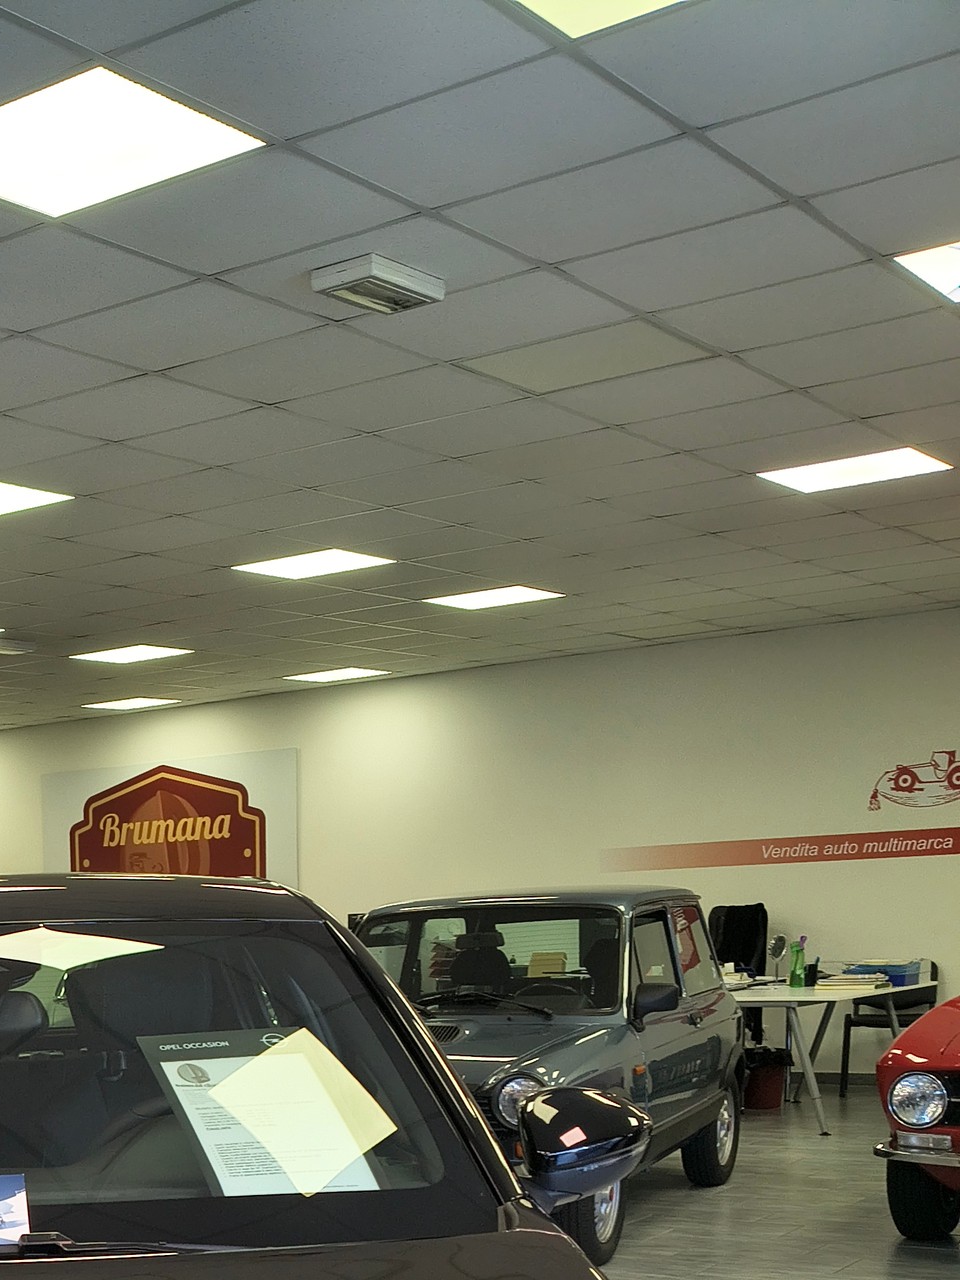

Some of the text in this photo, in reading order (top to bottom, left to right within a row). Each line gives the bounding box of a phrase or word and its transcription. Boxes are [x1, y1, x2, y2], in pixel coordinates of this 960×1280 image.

[99, 811, 232, 848] Brumana
[761, 837, 954, 859] Vendita auto multimarca
[182, 1040, 230, 1050] OCCASION
